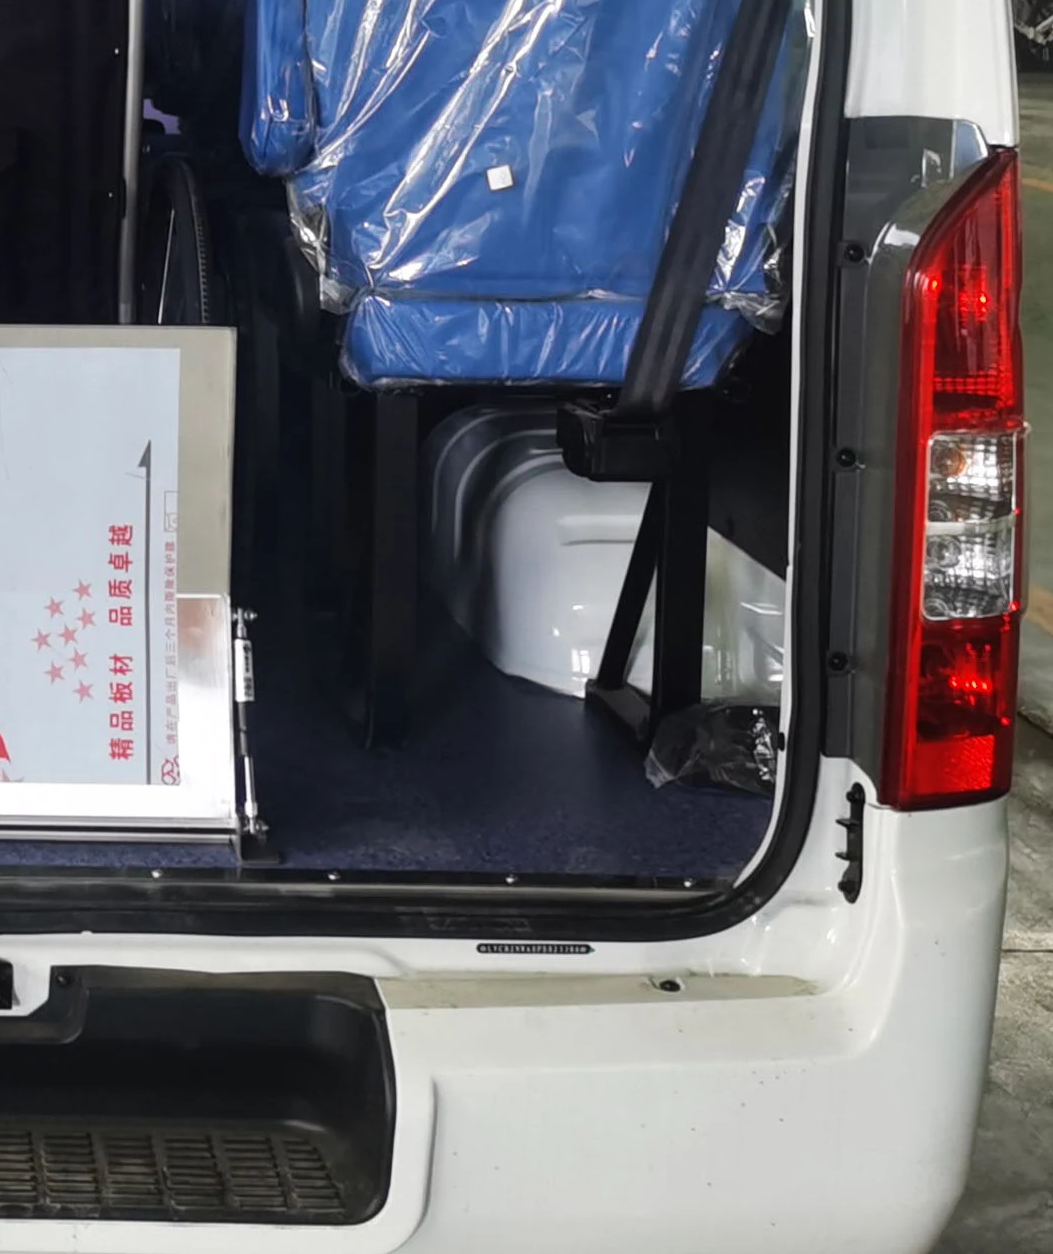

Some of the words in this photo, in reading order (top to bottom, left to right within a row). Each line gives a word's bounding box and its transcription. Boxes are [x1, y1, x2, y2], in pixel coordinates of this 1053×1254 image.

[108, 525, 133, 626] 品质卓越
[109, 654, 134, 760] 精品板材
